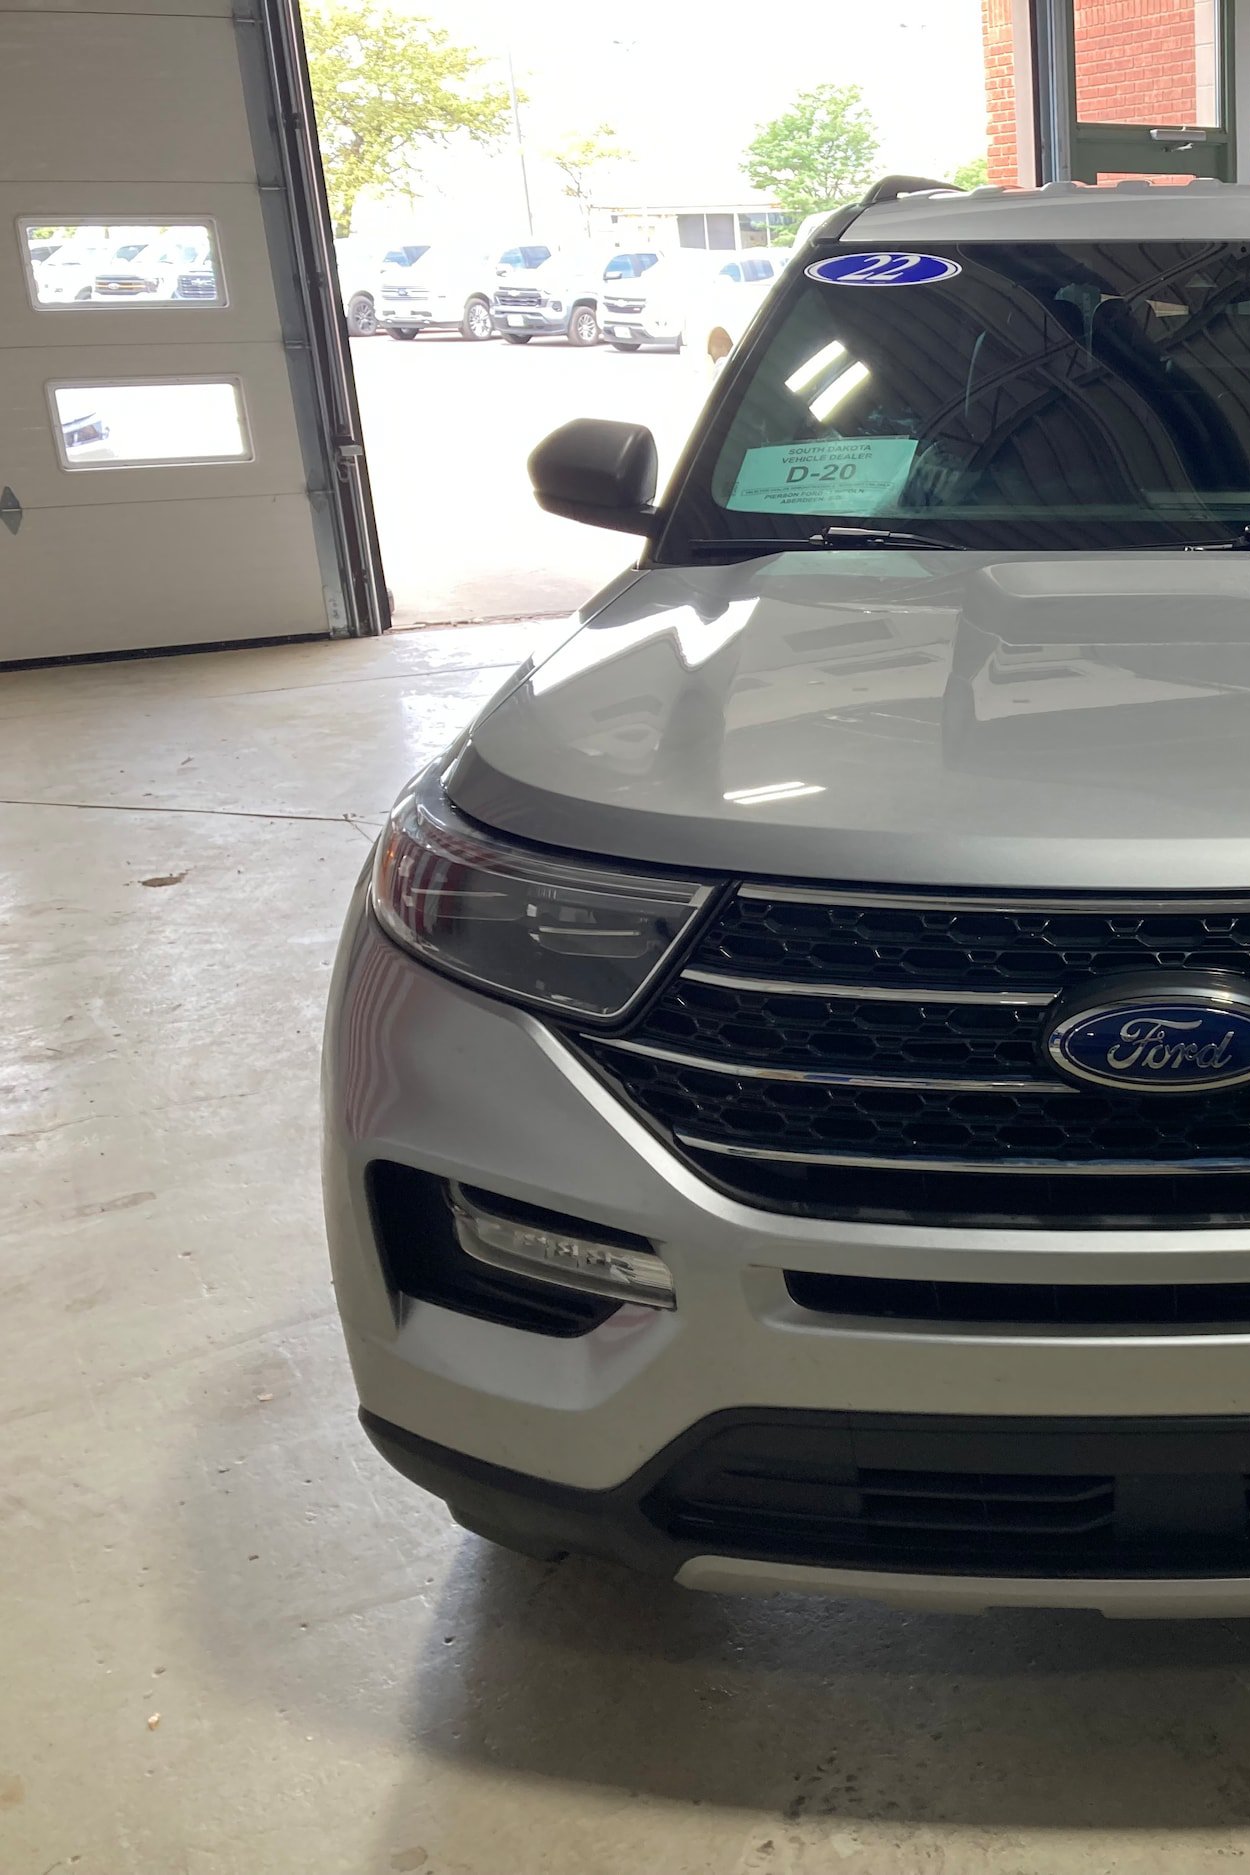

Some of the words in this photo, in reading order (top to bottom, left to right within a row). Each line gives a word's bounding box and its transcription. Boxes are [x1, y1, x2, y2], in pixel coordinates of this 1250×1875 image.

[837, 254, 922, 281] 22
[829, 444, 872, 452] DAKOTA
[782, 454, 827, 464] VEHICLE
[829, 453, 873, 461] DEALER
[786, 463, 857, 483] D-20
[1106, 1018, 1235, 1070] Ford
